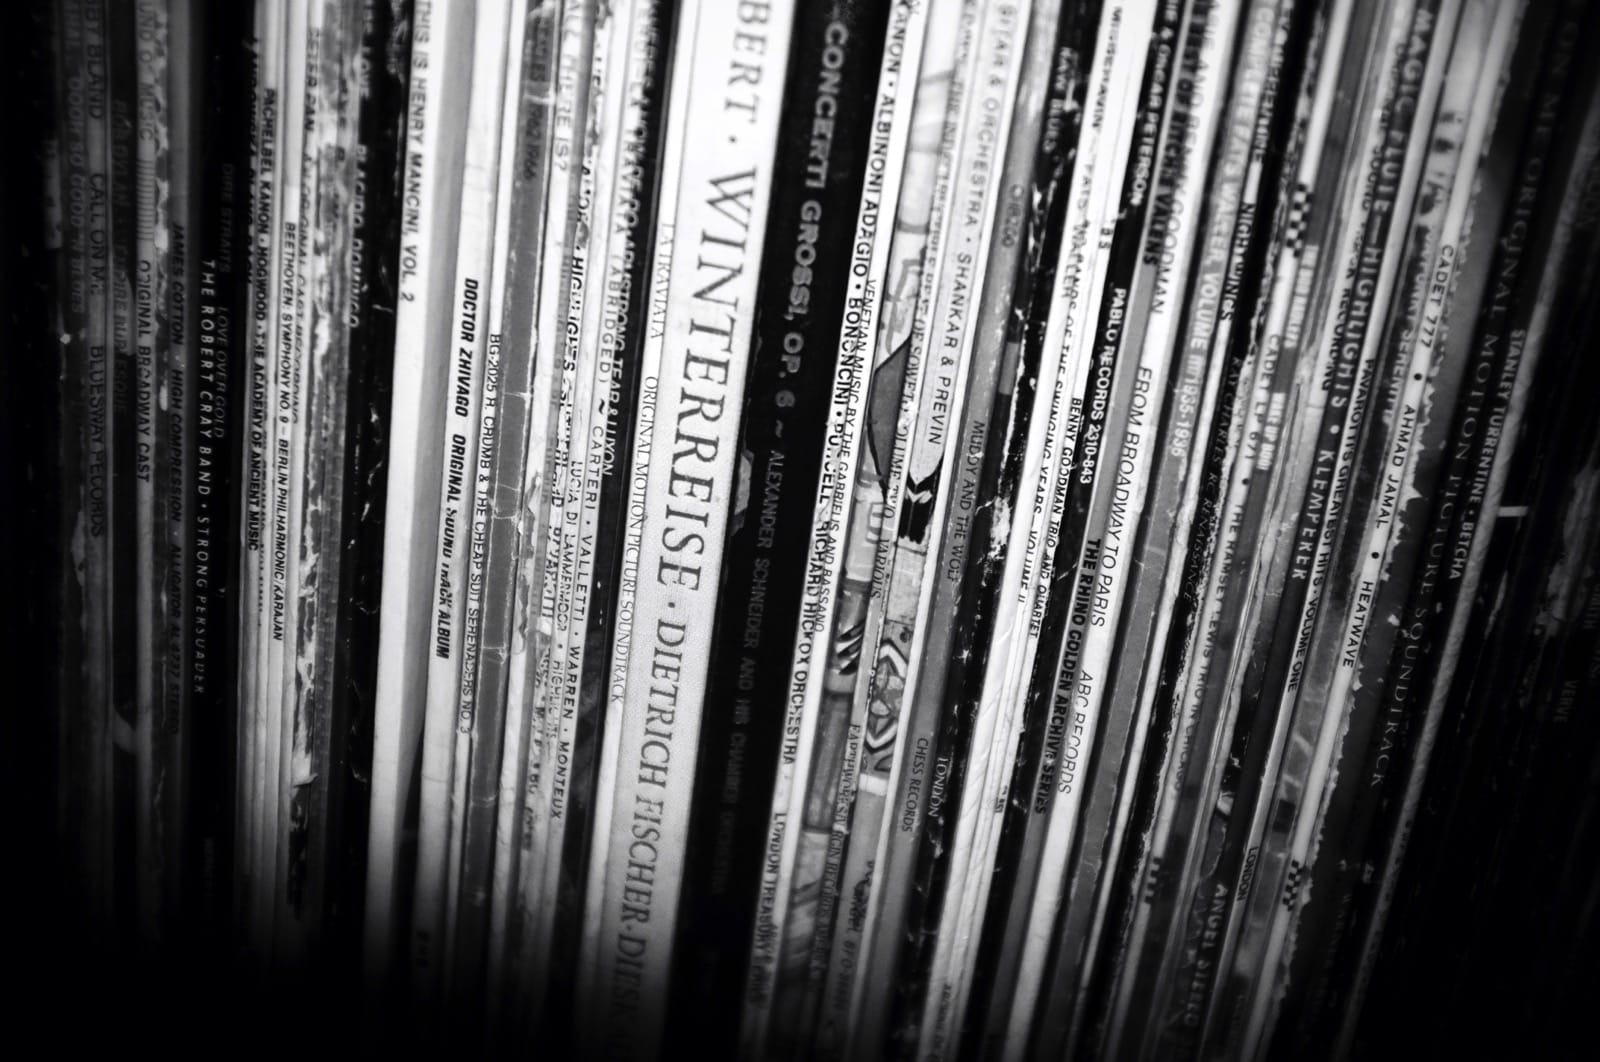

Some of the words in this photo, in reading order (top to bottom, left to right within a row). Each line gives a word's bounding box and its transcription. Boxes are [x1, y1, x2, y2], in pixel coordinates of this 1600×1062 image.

[415, 1, 432, 42] THIS
[1180, 22, 1204, 72] BEST
[87, 45, 103, 118] BLAND
[414, 52, 429, 68] IS
[725, 0, 771, 124] BERT
[1174, 78, 1193, 104] OF
[1394, 7, 1434, 117] MAGIC
[260, 88, 276, 173] PACHELBEL
[409, 79, 427, 142] HENRY
[804, 21, 847, 188] CONCERTI
[552, 137, 572, 173] IS?
[865, 93, 893, 193] ALBINONI
[963, 96, 1000, 228] ORCHESTRA
[1127, 111, 1160, 206] PETERSON
[88, 173, 104, 226] CALL
[257, 181, 272, 233] KANON
[1143, 192, 1172, 266] VALENS
[89, 230, 104, 259] ON
[172, 223, 185, 275] JAMES
[785, 199, 823, 323] GROSSI,
[852, 198, 878, 277] ADAGIO
[1489, 156, 1544, 322] ORIGINAL
[138, 260, 152, 337] ORIGINAL
[202, 259, 215, 295] THE
[254, 247, 270, 320] HOGWOOD
[400, 292, 414, 302] 2
[943, 252, 973, 349] SHANKAR
[1428, 243, 1455, 307] CADET
[171, 280, 184, 344] COTTON
[215, 307, 230, 346] LOVE
[459, 277, 478, 342] DOCTOR
[854, 278, 877, 351] VENETIAN
[1105, 287, 1126, 342] PABLO
[1189, 272, 1221, 351] VOLUME
[1418, 313, 1438, 349] 777
[199, 305, 214, 382] ROBERT
[214, 351, 228, 391] OVER
[279, 312, 294, 386] SYMPHONY
[485, 333, 502, 392] BG-2025
[777, 330, 804, 379] OP.
[833, 296, 863, 405] BONONCINI
[940, 355, 955, 368] &
[1225, 356, 1243, 388] RAY
[1257, 331, 1282, 391] CADET
[1495, 327, 1526, 401] STANLEY
[90, 346, 105, 441] BLUESWAY
[137, 347, 152, 434] BROADWAY
[171, 369, 183, 407] HIGH
[251, 364, 266, 428] ACADEMY
[278, 390, 291, 411] NO.
[453, 347, 473, 417] ZHIVAGO
[661, 161, 756, 592] WINTERREISE
[774, 388, 796, 408] 6
[847, 355, 865, 404] MUSIC
[1091, 344, 1115, 421] RECORDS
[1128, 367, 1154, 426] FROM
[1454, 333, 1501, 461] MOTION
[198, 390, 212, 438] CRAY
[212, 395, 226, 437] GOLD
[250, 432, 263, 449] OF
[479, 415, 495, 469] CRUMB
[636, 375, 658, 458] ORIGINAL
[844, 407, 857, 427] BY
[927, 375, 952, 447] PREVIN
[1041, 379, 1063, 460] SWINGING
[1063, 397, 1081, 441] BENNY
[1209, 391, 1236, 464] CHARLES
[1389, 403, 1416, 470] AHMAD
[138, 442, 151, 481] CAST
[170, 413, 183, 521] COMPRESSION
[197, 446, 211, 495] BAND
[275, 438, 289, 484] BERLIN
[446, 434, 466, 503] ORIGINAL
[583, 425, 606, 509] CARTERI
[839, 430, 854, 458] THE
[965, 421, 986, 475] MUDDY
[1079, 422, 1101, 485] 2310-843
[1467, 404, 1506, 505] TURRENTINE
[91, 451, 106, 536] RECORDS
[248, 453, 262, 506] ANCIENT
[475, 488, 489, 516] THE
[628, 461, 648, 530] MOTION
[757, 449, 785, 548] ALEXANDER
[959, 479, 976, 511] AND
[1051, 447, 1072, 514] GOODMAN
[1106, 432, 1141, 541] BROADWAY
[1374, 472, 1399, 530] JAMAL
[246, 511, 260, 550] MUSIC
[471, 521, 487, 568] CHEAP
[565, 511, 578, 524] DI
[953, 514, 970, 541] THE
[1045, 519, 1060, 548] TRIO
[1228, 503, 1245, 534] THE
[1292, 450, 1334, 581] KLEMPERER
[195, 516, 209, 588] STRONG
[571, 534, 593, 622] VALLETTI
[621, 532, 641, 597] PICTURE
[804, 519, 830, 597] RICHARD
[823, 534, 838, 563] AND
[868, 538, 890, 599] VARIOUS
[1082, 536, 1101, 570] THE
[1100, 544, 1120, 570] TO
[1181, 497, 1214, 600] RENAISSANCE
[1213, 539, 1237, 605] RAMSEY
[1311, 551, 1330, 588] HITS
[1446, 520, 1475, 582] BETCHA
[468, 572, 483, 602] SUIT
[743, 556, 770, 649] SCHNEIDER
[812, 567, 833, 632] BASSANO
[1028, 584, 1047, 638] QUARTET
[1071, 573, 1094, 625] RHINO
[1089, 573, 1114, 628] PARIS
[435, 611, 452, 660] ALBUM
[609, 599, 633, 703] SOUNDTRACK
[795, 600, 818, 665] HICKOX
[1294, 597, 1319, 660] VOLUME
[1341, 579, 1373, 667] HEATWAVE
[560, 645, 581, 720] WARREN
[737, 656, 756, 690] AND
[1058, 629, 1082, 691] GOLDEN
[1074, 670, 1095, 708] ABC
[1286, 660, 1303, 693] ONE
[638, 619, 685, 789] DIETRICH
[779, 669, 808, 766] ORCHESTRA
[1368, 606, 1430, 789] SOUNDTRACK
[548, 740, 570, 823] MONTEUX
[911, 737, 930, 776] CHESS
[1057, 711, 1087, 795] RECORDS
[901, 778, 922, 834] RECORDS
[926, 756, 949, 817] LONDON
[1033, 764, 1055, 815] SERIES
[765, 811, 788, 874] LONDON
[1235, 845, 1260, 903] LONDON
[1200, 882, 1229, 952] ANGEL
